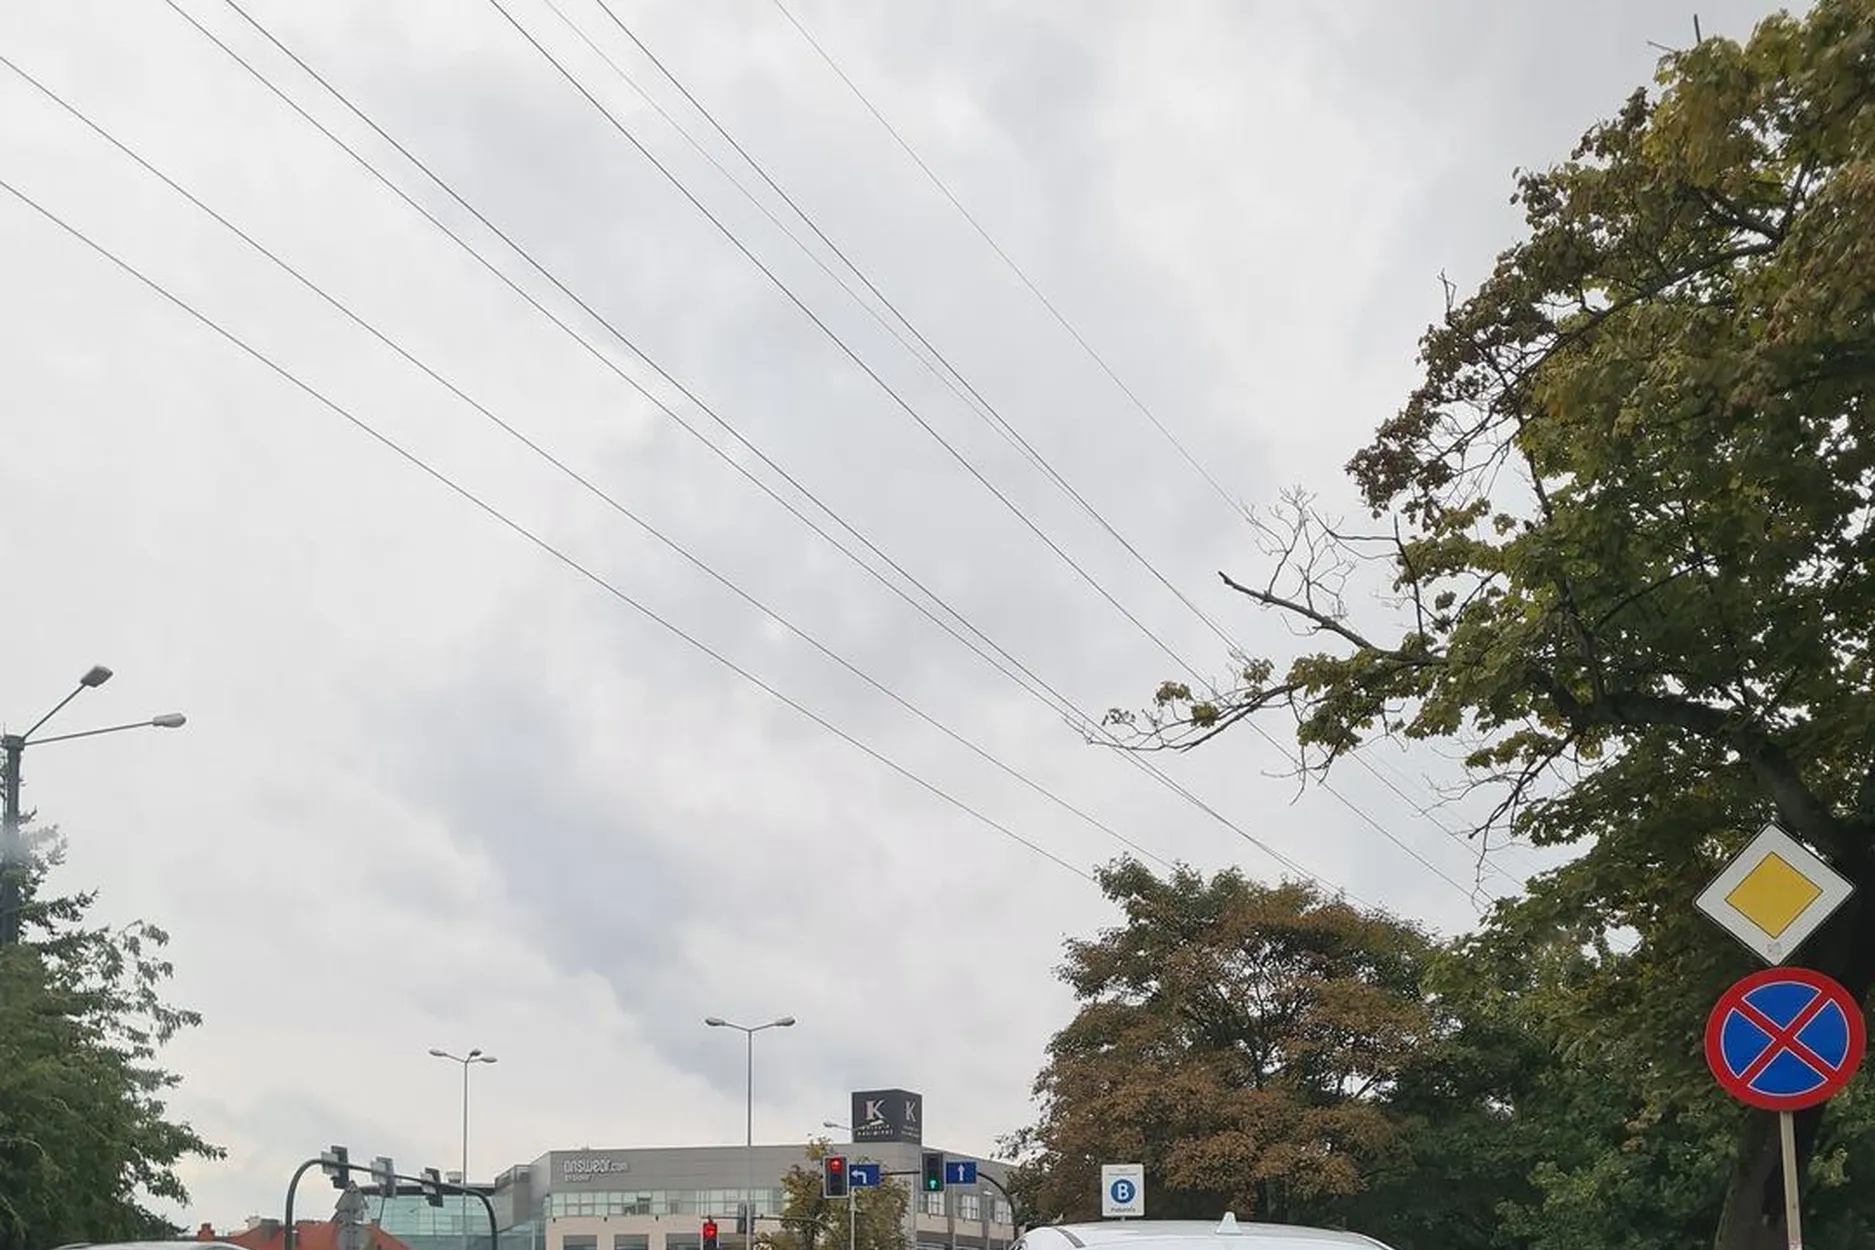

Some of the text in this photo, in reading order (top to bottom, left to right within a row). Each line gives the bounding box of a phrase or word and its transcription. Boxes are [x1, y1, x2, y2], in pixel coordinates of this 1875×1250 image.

[866, 1100, 885, 1120] K
[905, 1100, 917, 1122] K
[1117, 1183, 1129, 1200] B
